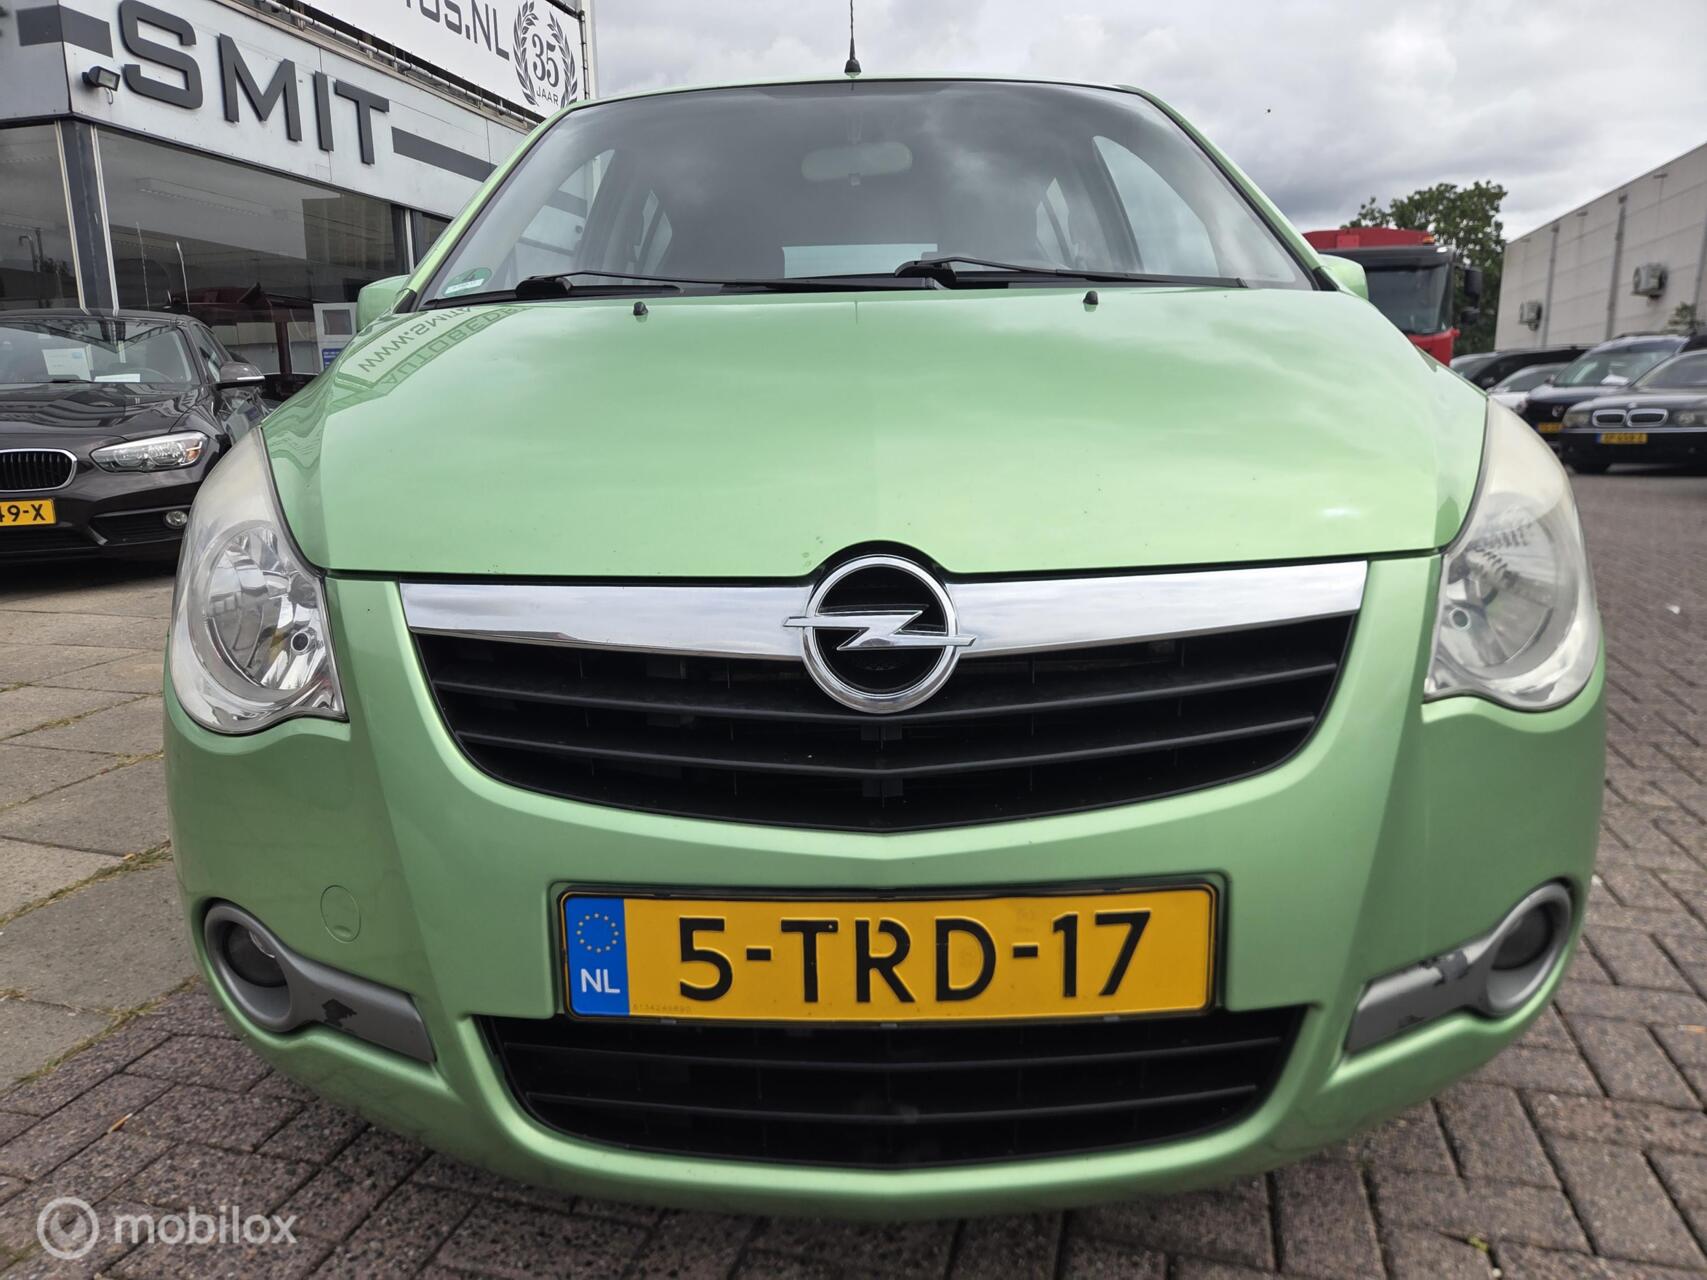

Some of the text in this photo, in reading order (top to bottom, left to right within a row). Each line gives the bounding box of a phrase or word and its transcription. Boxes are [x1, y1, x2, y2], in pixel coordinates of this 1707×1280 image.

[406, 0, 510, 61] S.NL
[119, 0, 390, 166] SMIT
[532, 33, 560, 88] 35
[535, 86, 559, 106] JAAR
[580, 967, 621, 994] NL
[678, 910, 1151, 1003] 5-TRD-17
